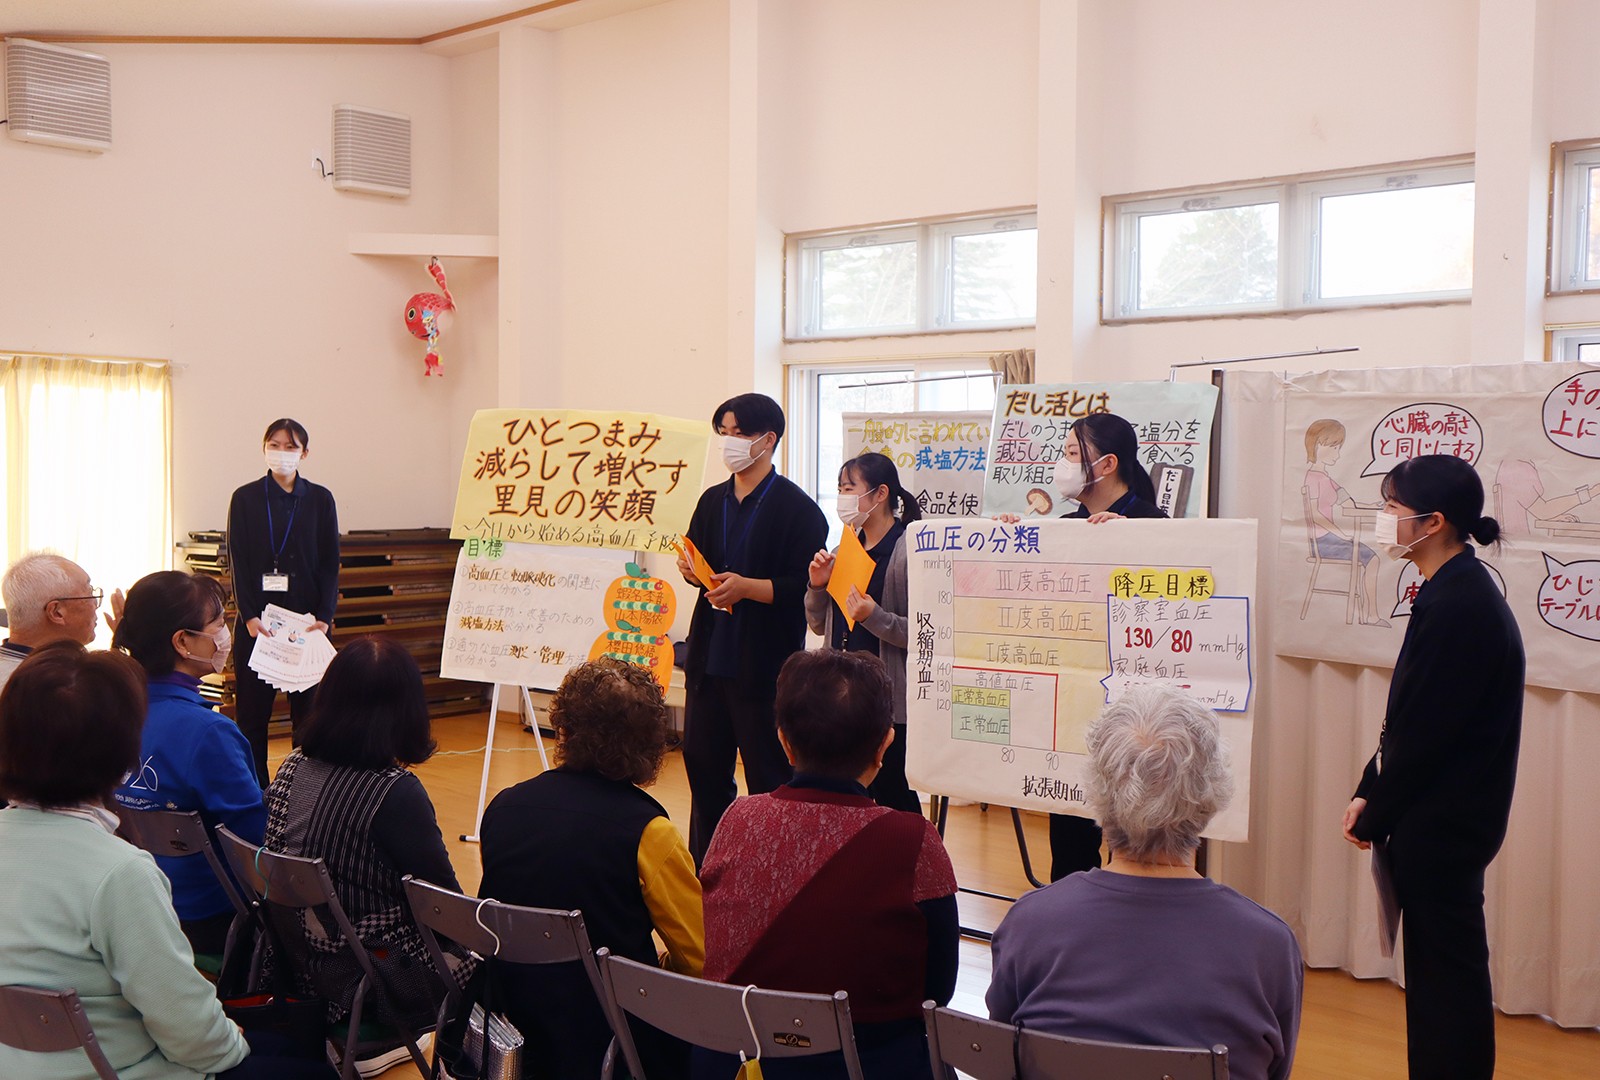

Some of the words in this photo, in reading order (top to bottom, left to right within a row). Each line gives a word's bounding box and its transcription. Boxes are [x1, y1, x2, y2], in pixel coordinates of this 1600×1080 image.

[1005, 390, 1111, 418] だし活とは
[503, 416, 662, 455] ひとつまみ
[848, 418, 990, 445] 一般的に言われてい
[1384, 410, 1471, 437] 心臓の高さ
[1550, 410, 1598, 438] 上に
[1137, 443, 1194, 465] 食べる
[1380, 437, 1476, 463] と同じにする
[473, 446, 688, 495] 減らして増やす
[488, 483, 657, 526] 里見の笑顔
[467, 537, 503, 559] 目標
[915, 524, 1041, 554] 血圧の分類
[923, 555, 952, 578] mmHg
[938, 590, 953, 604] 180
[1114, 572, 1211, 598] 降圧目標
[1111, 598, 1213, 625] 診察室血圧
[937, 627, 952, 640] 160
[916, 611, 936, 701] 収縮期血圧
[1198, 634, 1248, 661] mmHg
[936, 662, 951, 676] 140
[1112, 653, 1188, 680] 家庭血圧
[936, 679, 950, 692] 130
[974, 671, 1035, 692] 高値血圧
[936, 698, 951, 711] 120
[953, 687, 1008, 708] 正常高血圧
[960, 714, 1009, 736] 正常血圧
[1000, 746, 1016, 764] 80
[1045, 752, 1060, 771] 90
[1022, 775, 1087, 806] 拡張期血
